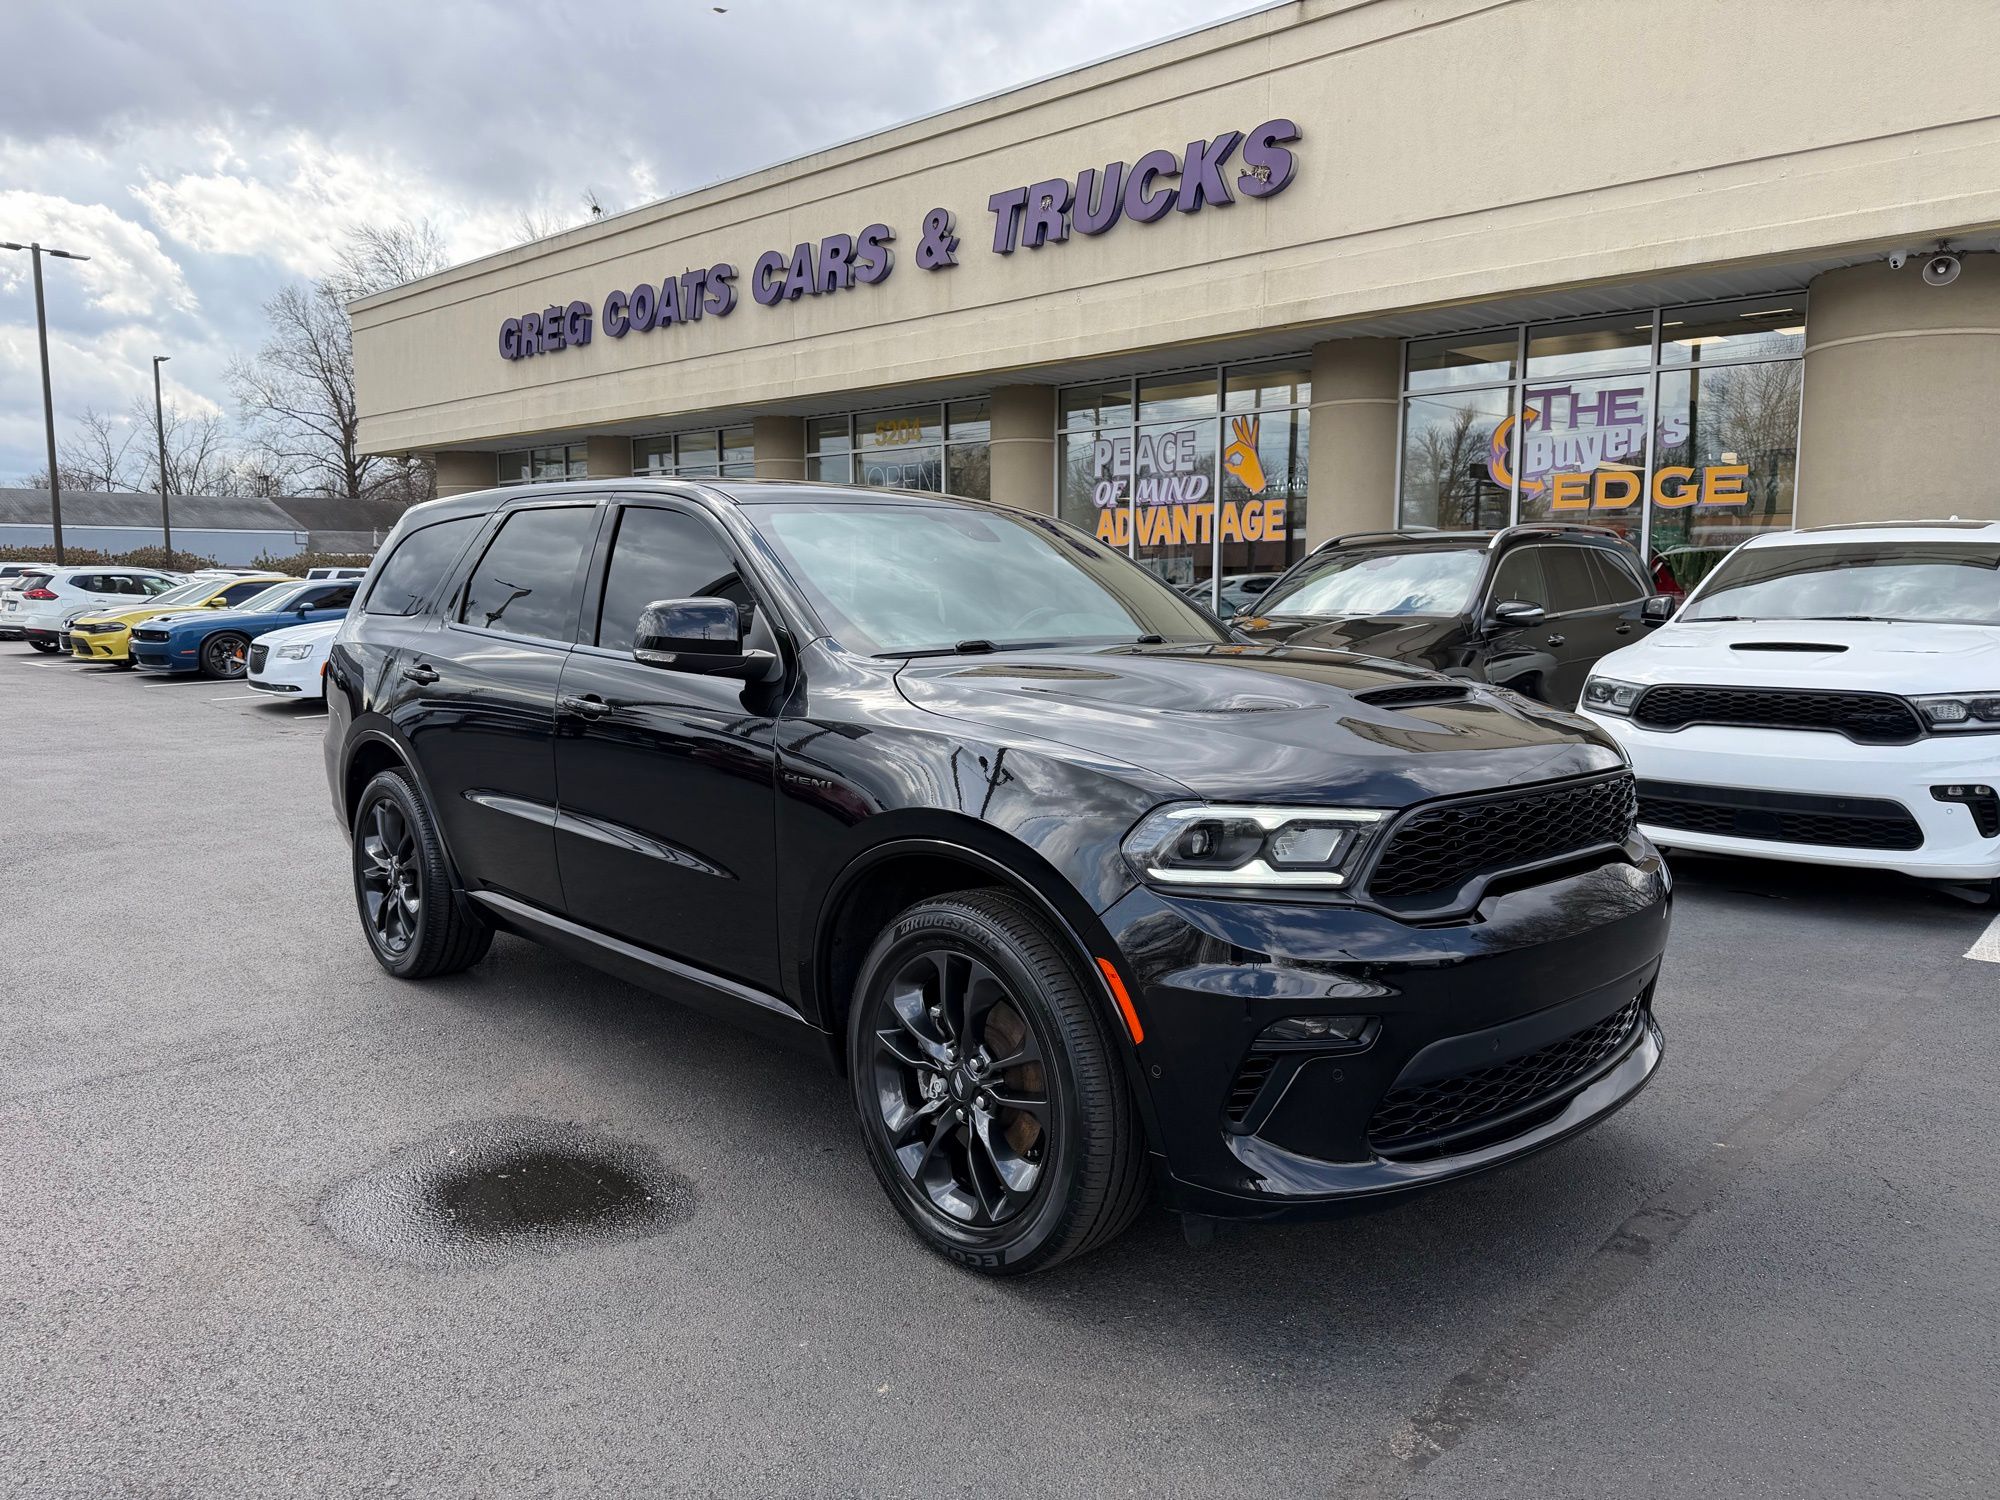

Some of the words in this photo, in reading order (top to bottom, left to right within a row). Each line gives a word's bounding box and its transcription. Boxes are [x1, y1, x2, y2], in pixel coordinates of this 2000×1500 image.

[499, 300, 592, 360] GREG
[602, 263, 738, 338] COATS
[751, 223, 896, 306] CARS
[915, 207, 960, 271] &
[987, 118, 1302, 256] TRUCKS
[1525, 385, 1645, 432] THE
[874, 417, 921, 447] 5204
[1093, 430, 1196, 478] PEACE
[866, 462, 935, 492] OPEN
[1093, 480, 1127, 508] OF
[1135, 475, 1210, 506] MIND
[1551, 464, 1749, 509] EDGE
[1095, 499, 1287, 547] ADVANTAGE
[784, 774, 833, 789] HEMI
[900, 914, 997, 951] BRIDGESTONE
